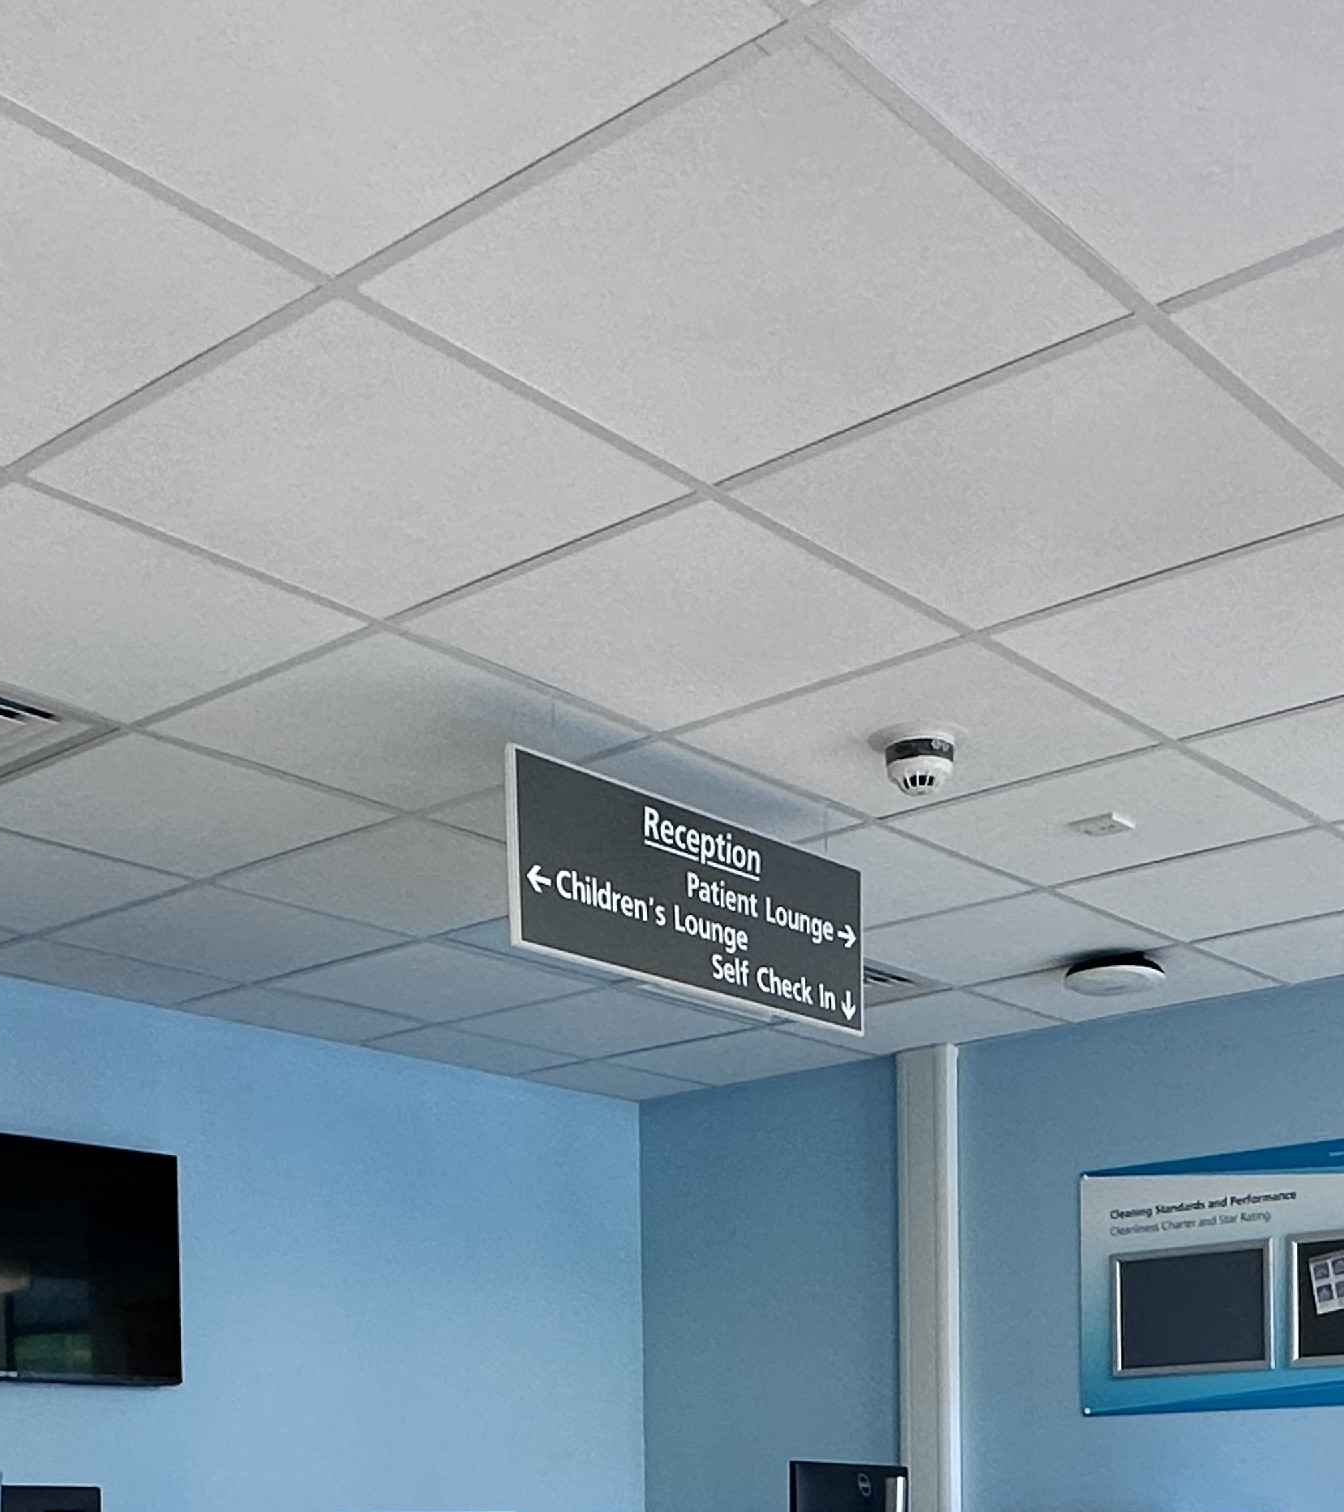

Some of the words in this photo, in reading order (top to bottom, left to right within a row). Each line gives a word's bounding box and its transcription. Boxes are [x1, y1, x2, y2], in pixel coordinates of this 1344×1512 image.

[643, 806, 761, 873] Reception
[556, 870, 667, 926] Children's
[674, 904, 748, 954] Lounge
[687, 872, 758, 918] Patient
[765, 896, 834, 944] Lounge
[711, 954, 750, 987] Self
[756, 966, 813, 1005] Check
[819, 983, 836, 1011] In
[1110, 1207, 1153, 1220] Cleaning
[1155, 1200, 1206, 1215] Standards
[1208, 1196, 1227, 1209] and
[1230, 1191, 1297, 1207] Performance
[1199, 1215, 1217, 1227] and
[1240, 1210, 1272, 1224] Rating
